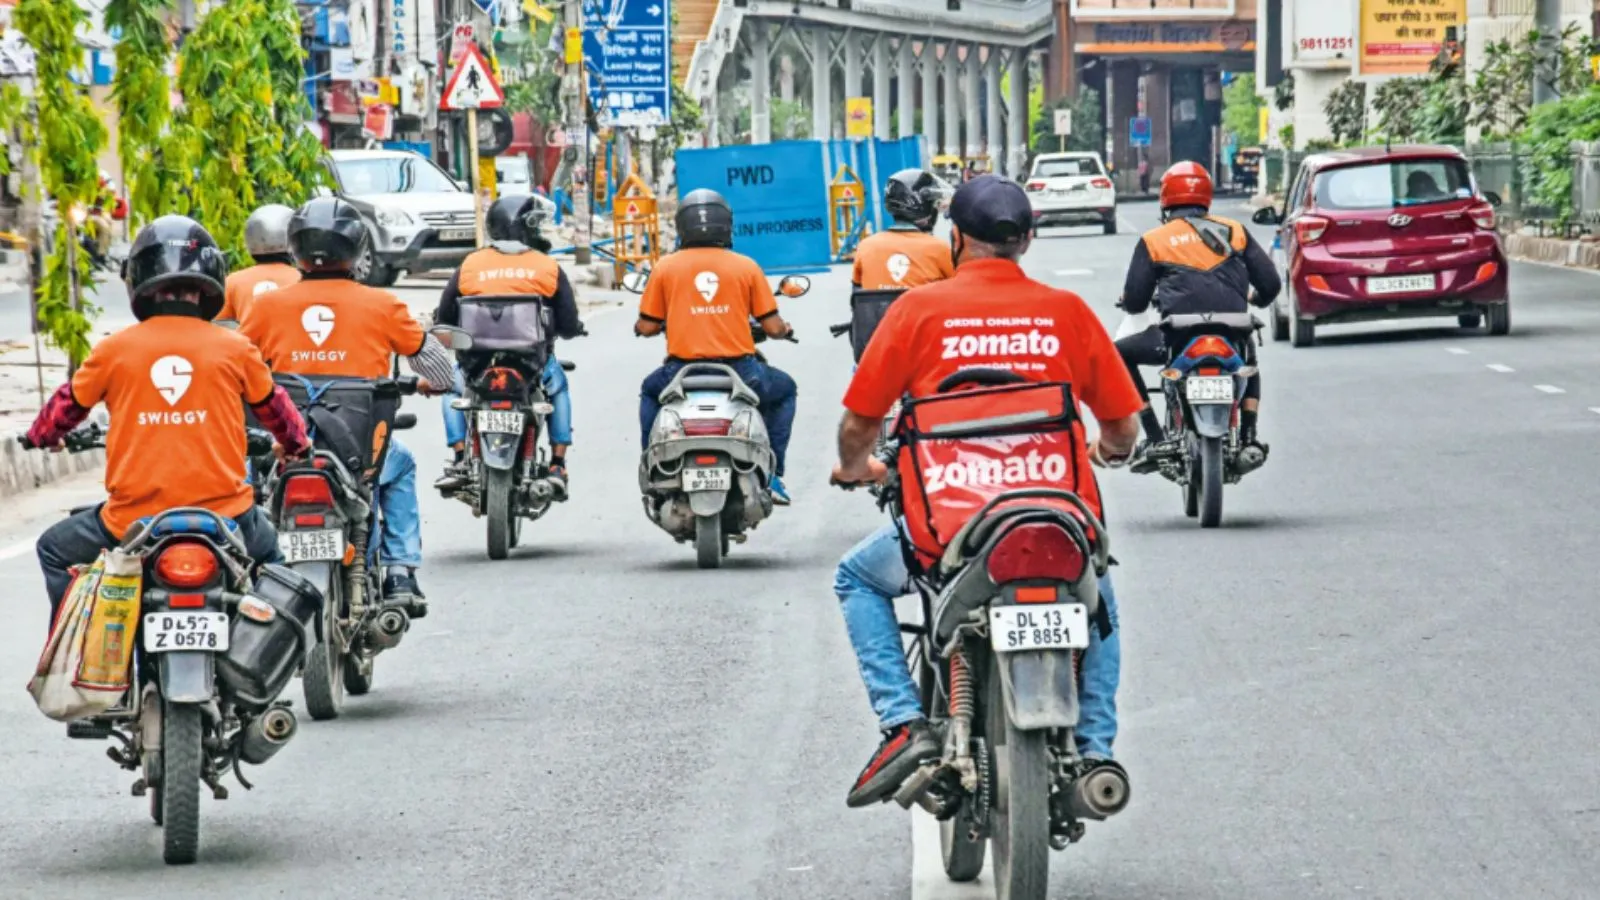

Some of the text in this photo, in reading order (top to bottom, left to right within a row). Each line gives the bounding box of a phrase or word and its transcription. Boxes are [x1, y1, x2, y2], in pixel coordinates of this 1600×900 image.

[634, 61, 661, 72] Nagar
[726, 164, 774, 187] PWD
[739, 222, 754, 237] IN
[757, 217, 824, 235] PROGRESS
[479, 267, 537, 282] SWIGGY
[690, 304, 730, 316] SWIGGY
[943, 316, 1055, 328] ORDER ONLINE ON
[941, 329, 1060, 360] zomato
[291, 350, 348, 362] SWIGGY
[138, 410, 207, 426] SWIGGY
[924, 448, 1067, 495] zomato
[1016, 610, 1062, 628] DL 13
[155, 632, 218, 648] Z 0578
[1007, 627, 1071, 647] SF 8851
